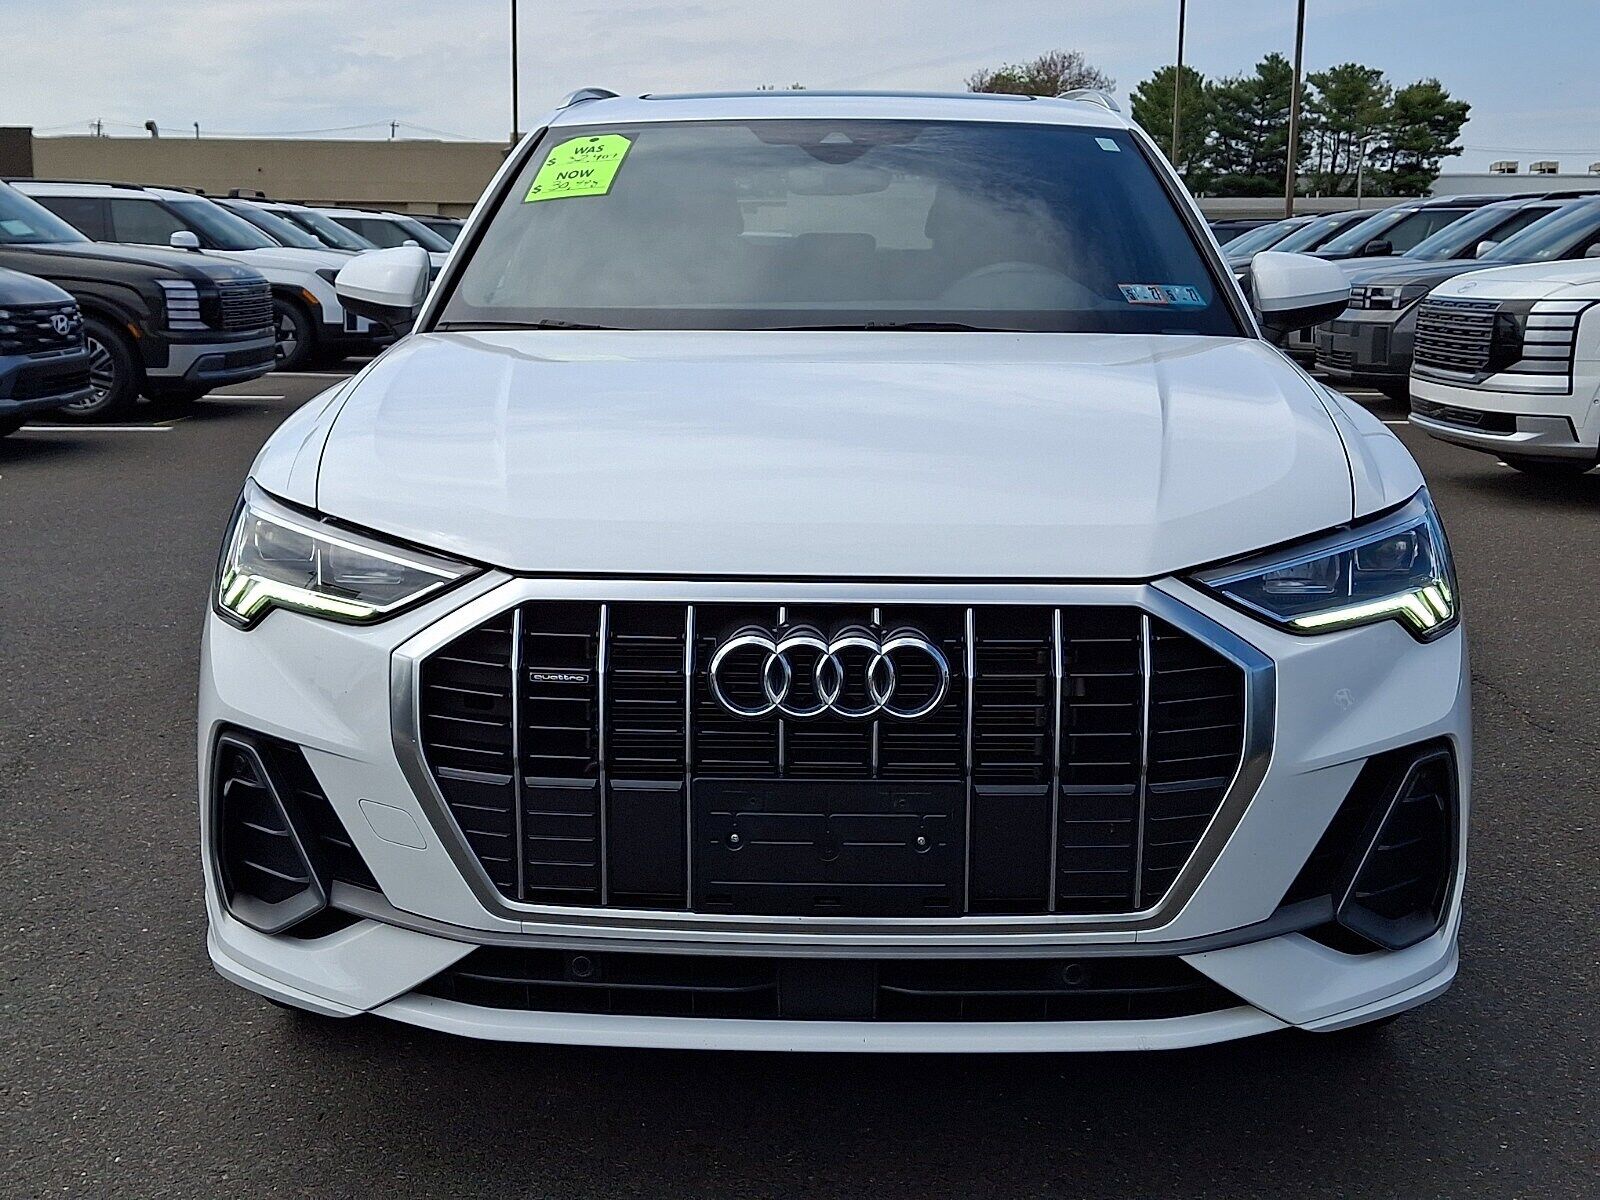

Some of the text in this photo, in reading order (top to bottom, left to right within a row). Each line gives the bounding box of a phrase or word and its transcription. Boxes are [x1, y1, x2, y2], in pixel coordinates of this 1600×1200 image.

[574, 144, 604, 155] WAS
[546, 158, 556, 166] $
[556, 169, 594, 180] NOW
[531, 185, 542, 194] $
[533, 674, 585, 682] quattro
